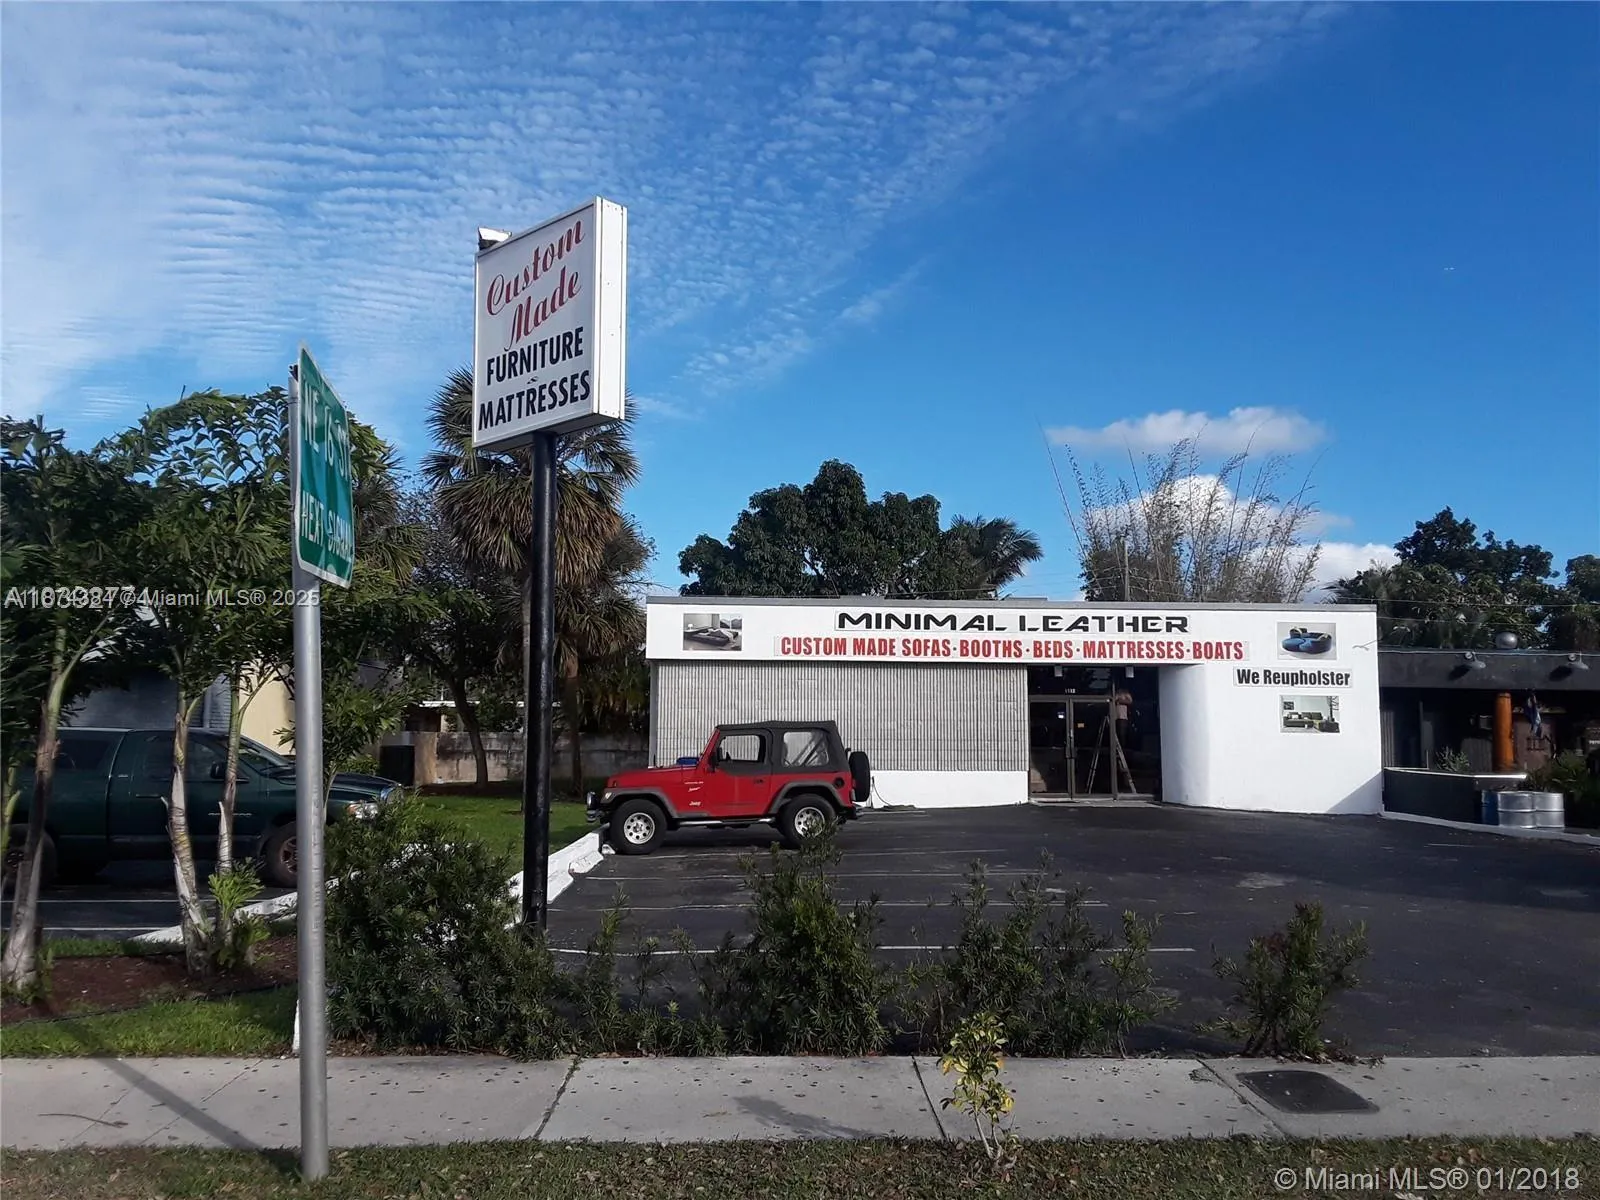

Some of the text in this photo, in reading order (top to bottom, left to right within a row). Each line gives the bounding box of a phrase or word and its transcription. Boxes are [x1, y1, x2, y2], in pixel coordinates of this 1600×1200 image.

[486, 220, 586, 316] Custom
[503, 265, 582, 352] Made
[487, 326, 584, 386] FURNITURE
[304, 381, 319, 453] NE
[324, 405, 334, 467] 16
[478, 369, 591, 431] MATTRESSES
[301, 490, 324, 547] NEXT
[781, 636, 1243, 660] CUSTOM MADE SOFAS BOOTHS BEDS MATTRESSES BOATS
[838, 612, 1189, 633] MINIMAL LEATHER
[1236, 669, 1351, 686] We Reupholster
